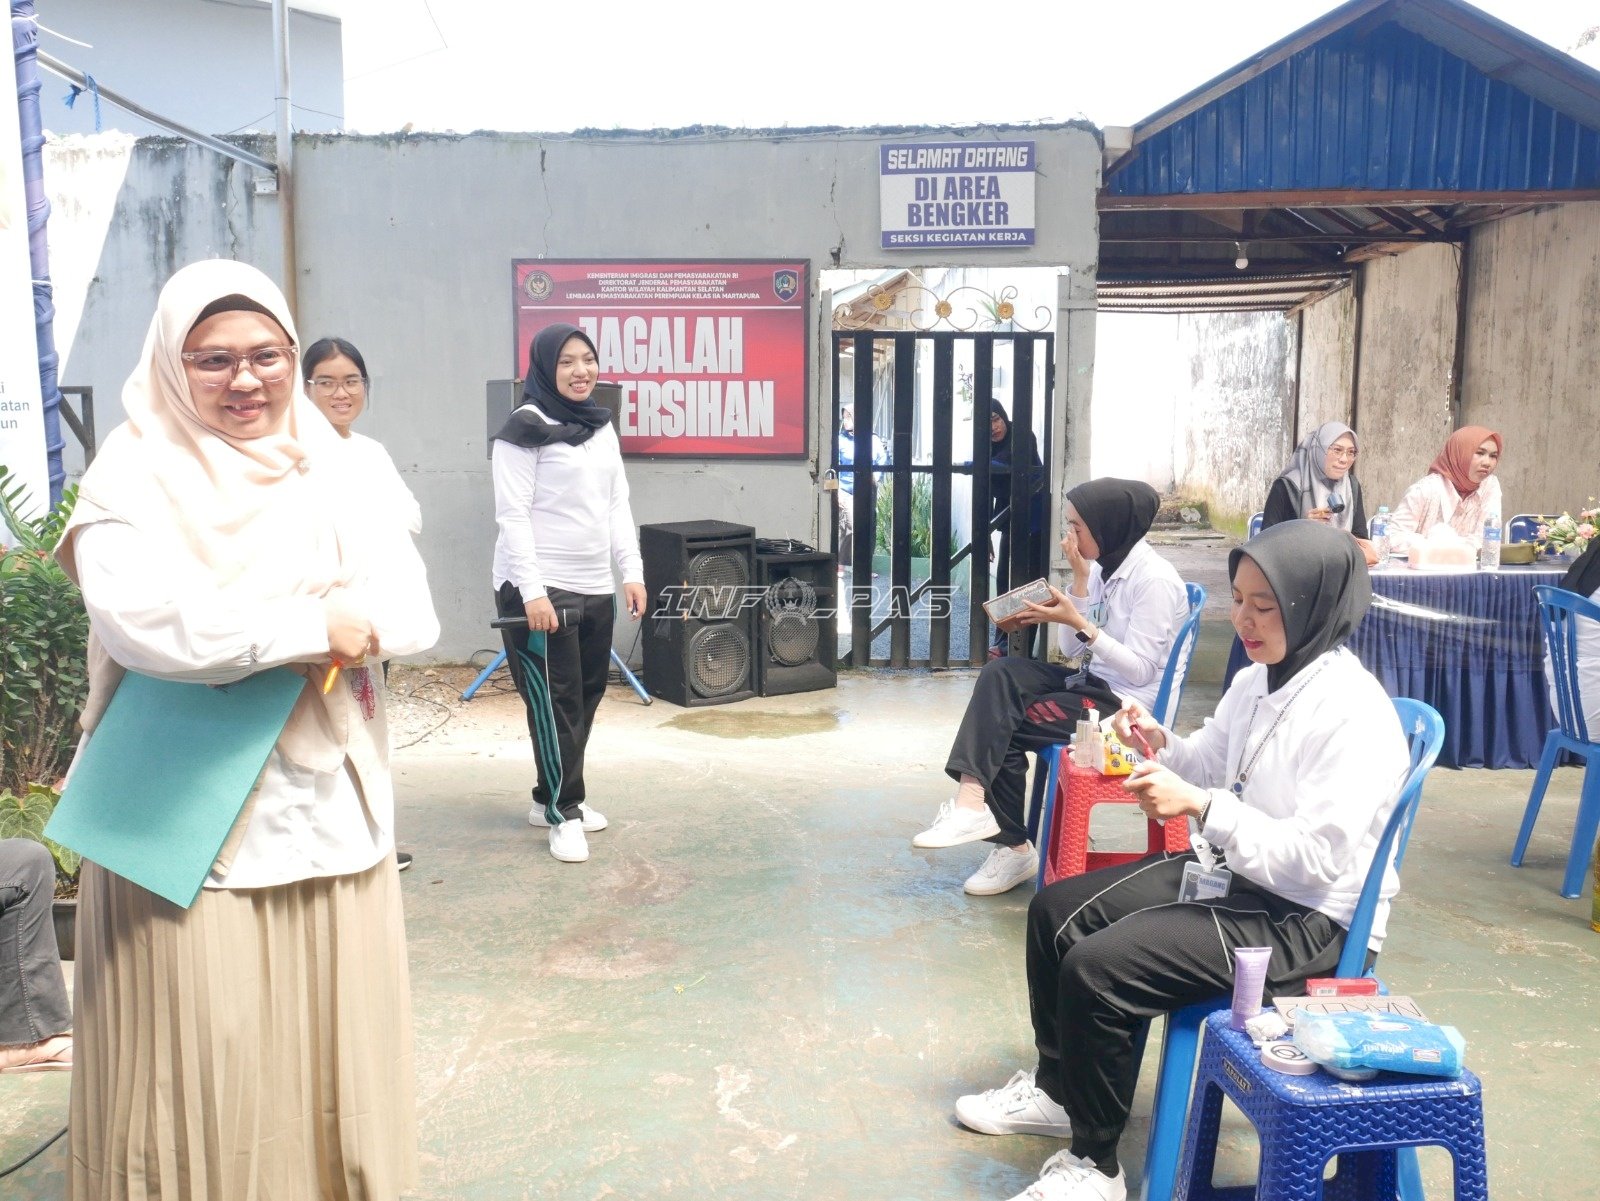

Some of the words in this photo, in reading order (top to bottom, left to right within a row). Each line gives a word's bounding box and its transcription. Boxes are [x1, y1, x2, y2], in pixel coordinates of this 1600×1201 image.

[888, 148, 963, 170] SELAMAT
[964, 146, 1029, 169] DATANG
[915, 177, 938, 201] DI
[943, 175, 1001, 201] AREA
[907, 201, 1009, 227] BENGKER
[890, 234, 924, 243] SEKSI
[926, 233, 986, 242] KEGIATAN
[988, 232, 1027, 241] KERJA
[618, 380, 774, 437] ERSIHAN
